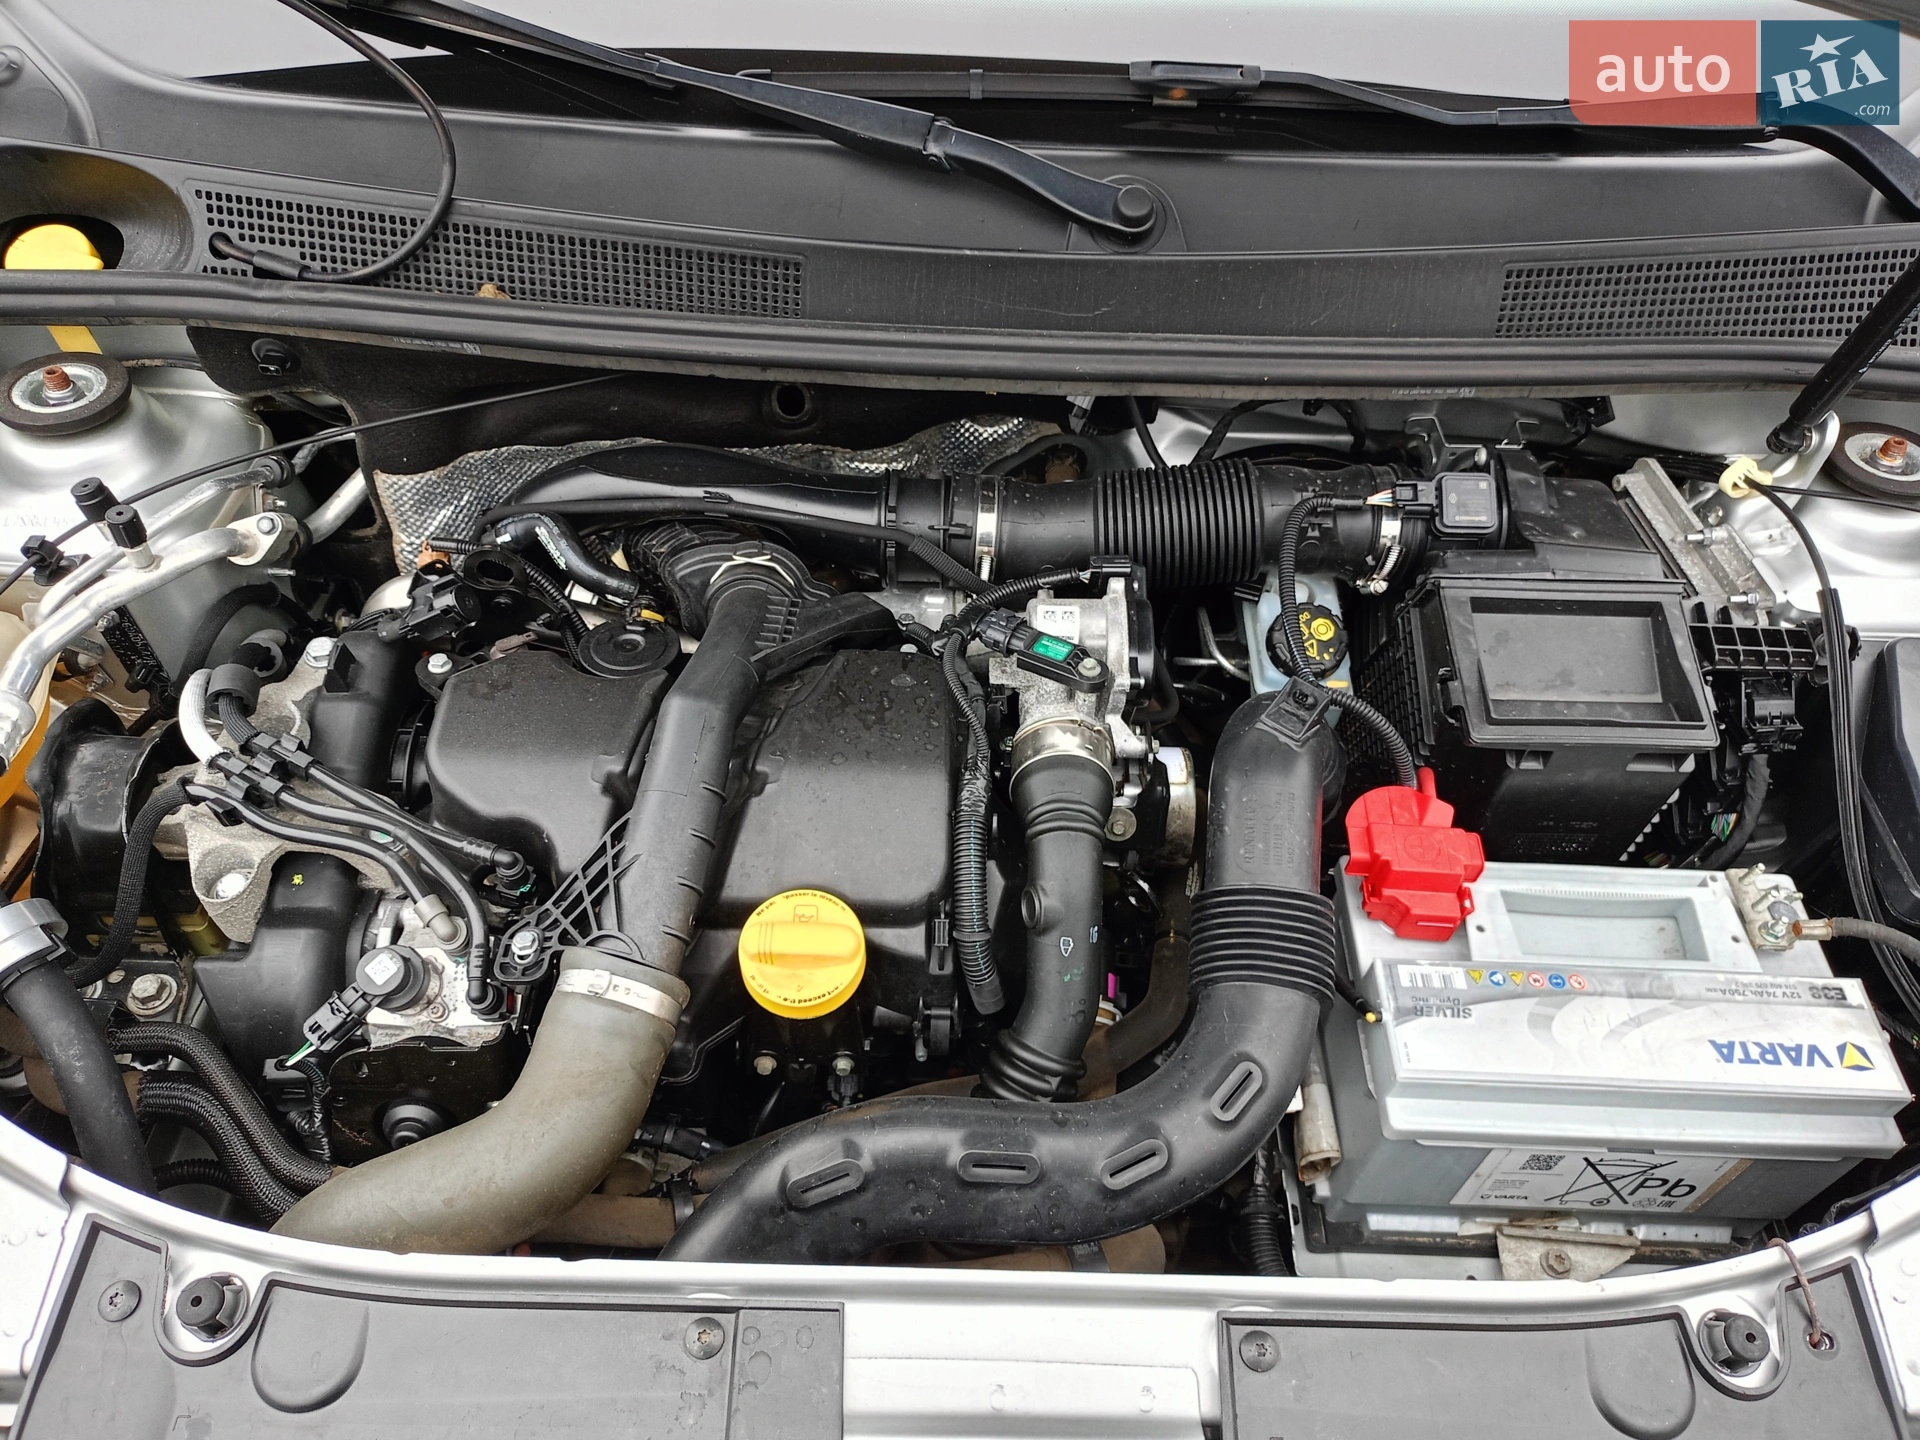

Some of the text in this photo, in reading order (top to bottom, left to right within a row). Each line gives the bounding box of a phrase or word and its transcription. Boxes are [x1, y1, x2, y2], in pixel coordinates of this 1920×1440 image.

[1750, 990, 1779, 999] 74Ah
[1782, 991, 1802, 999] 12V
[1808, 986, 1848, 1001] E38
[1414, 1005, 1472, 1020] SILVER
[1707, 1040, 1834, 1068] VARTA
[1627, 1177, 1697, 1198] Pb
